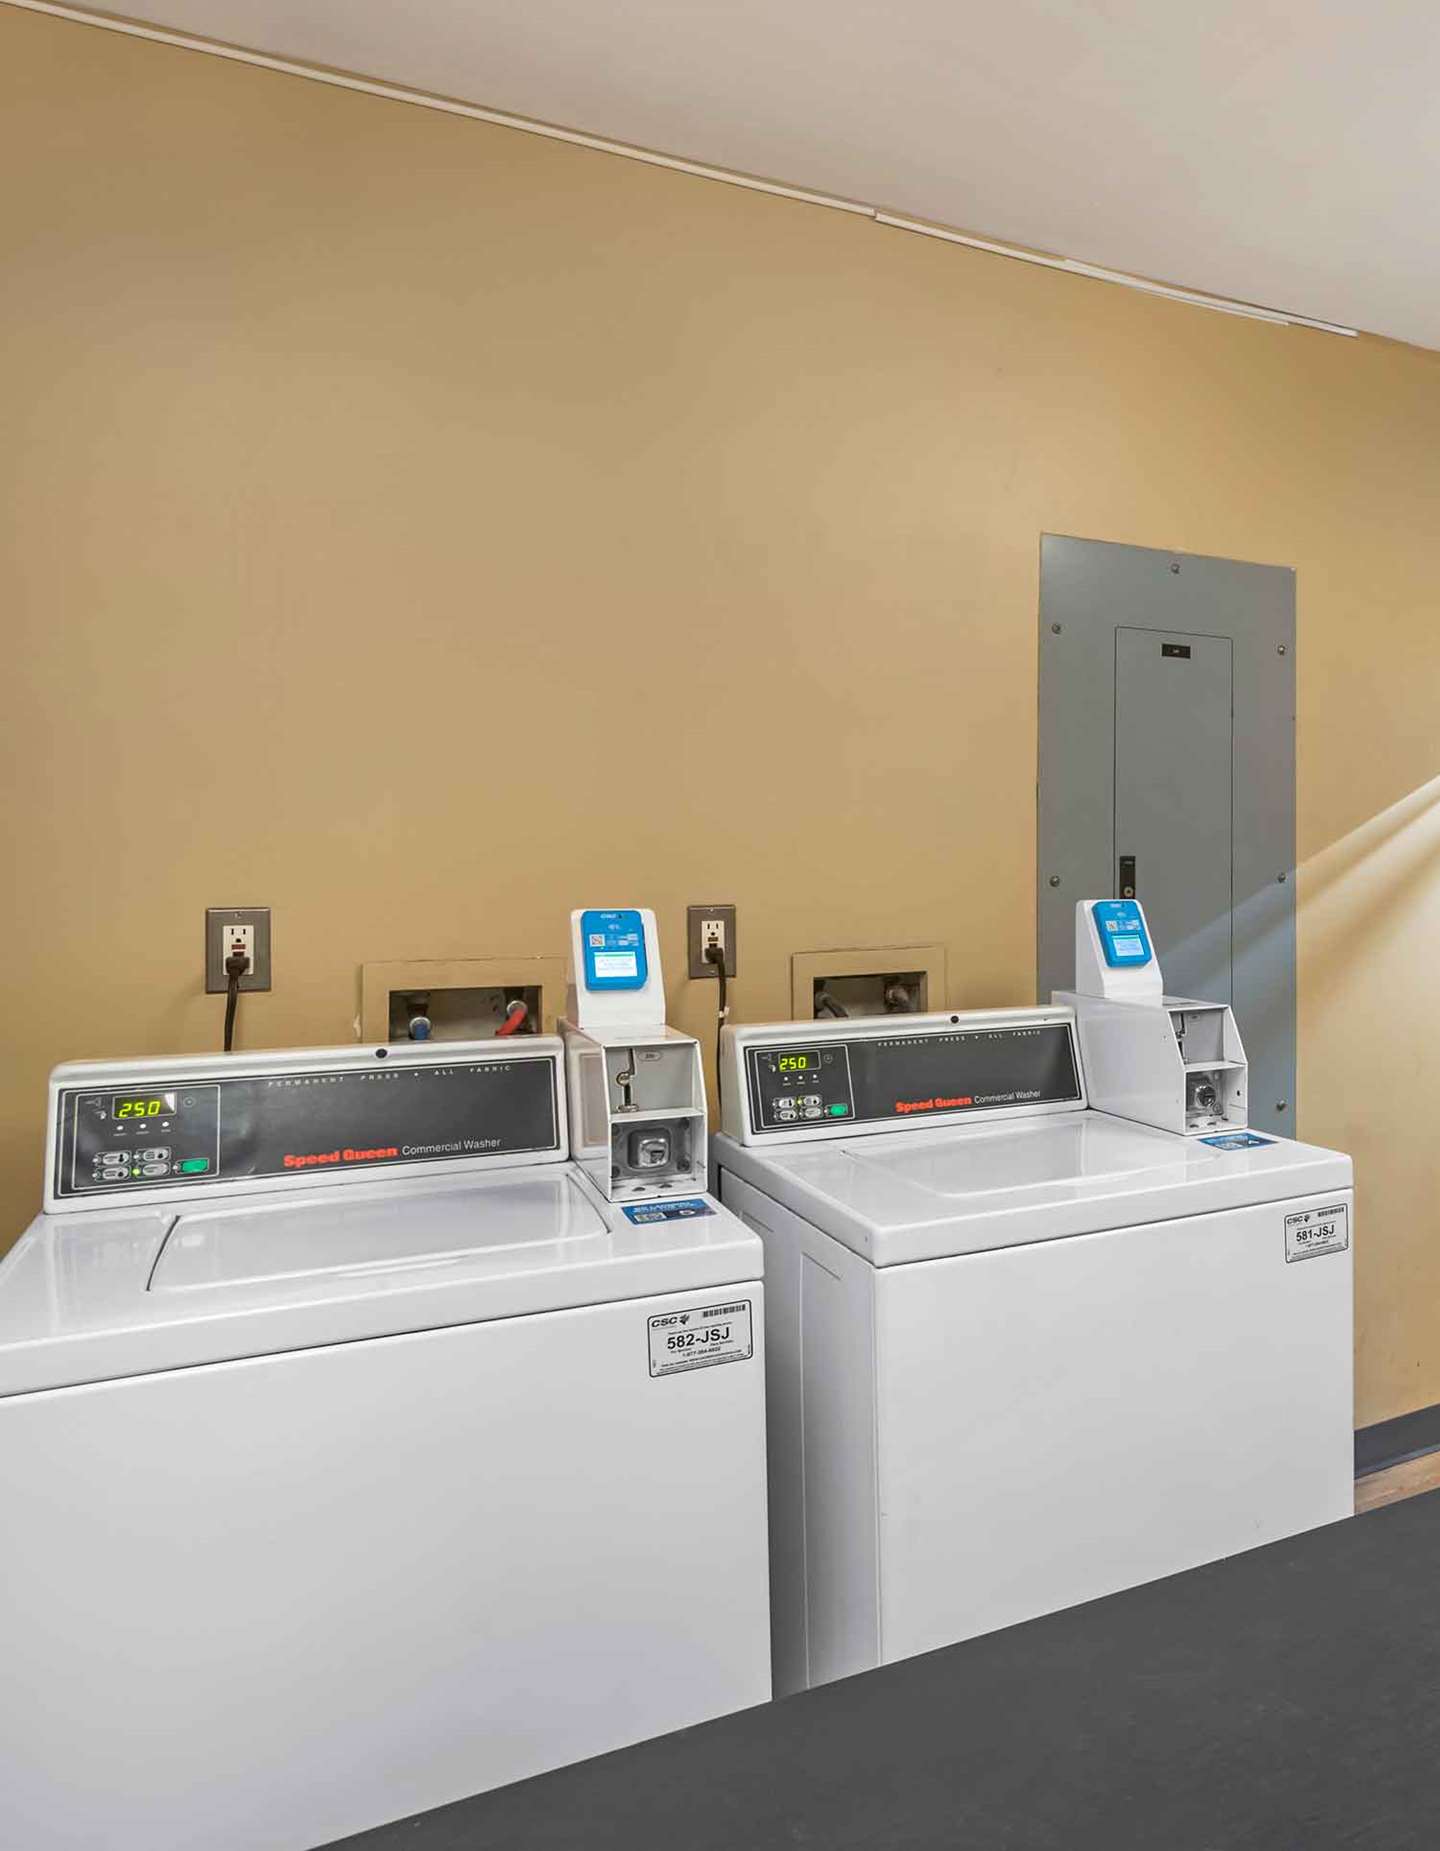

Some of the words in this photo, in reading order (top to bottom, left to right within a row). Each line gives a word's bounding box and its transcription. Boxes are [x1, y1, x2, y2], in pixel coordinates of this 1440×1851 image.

[779, 1056, 807, 1072] 250
[268, 1076, 345, 1088] PERMANENT
[360, 1072, 400, 1081] PRESS
[470, 1065, 512, 1073] FABRIC
[119, 1101, 161, 1119] 250
[895, 1100, 934, 1114] Speed
[935, 1096, 973, 1108] Queen
[974, 1092, 1015, 1105] Commercial
[1015, 1089, 1041, 1100] Washer
[283, 1151, 340, 1168] Speed
[343, 1147, 399, 1162] Queen
[402, 1140, 462, 1156] Commercial
[463, 1138, 501, 1150] Washer
[1296, 1224, 1335, 1242] 581-JSJ
[651, 1316, 678, 1328] CSC
[667, 1326, 730, 1350] 582-JSJ
